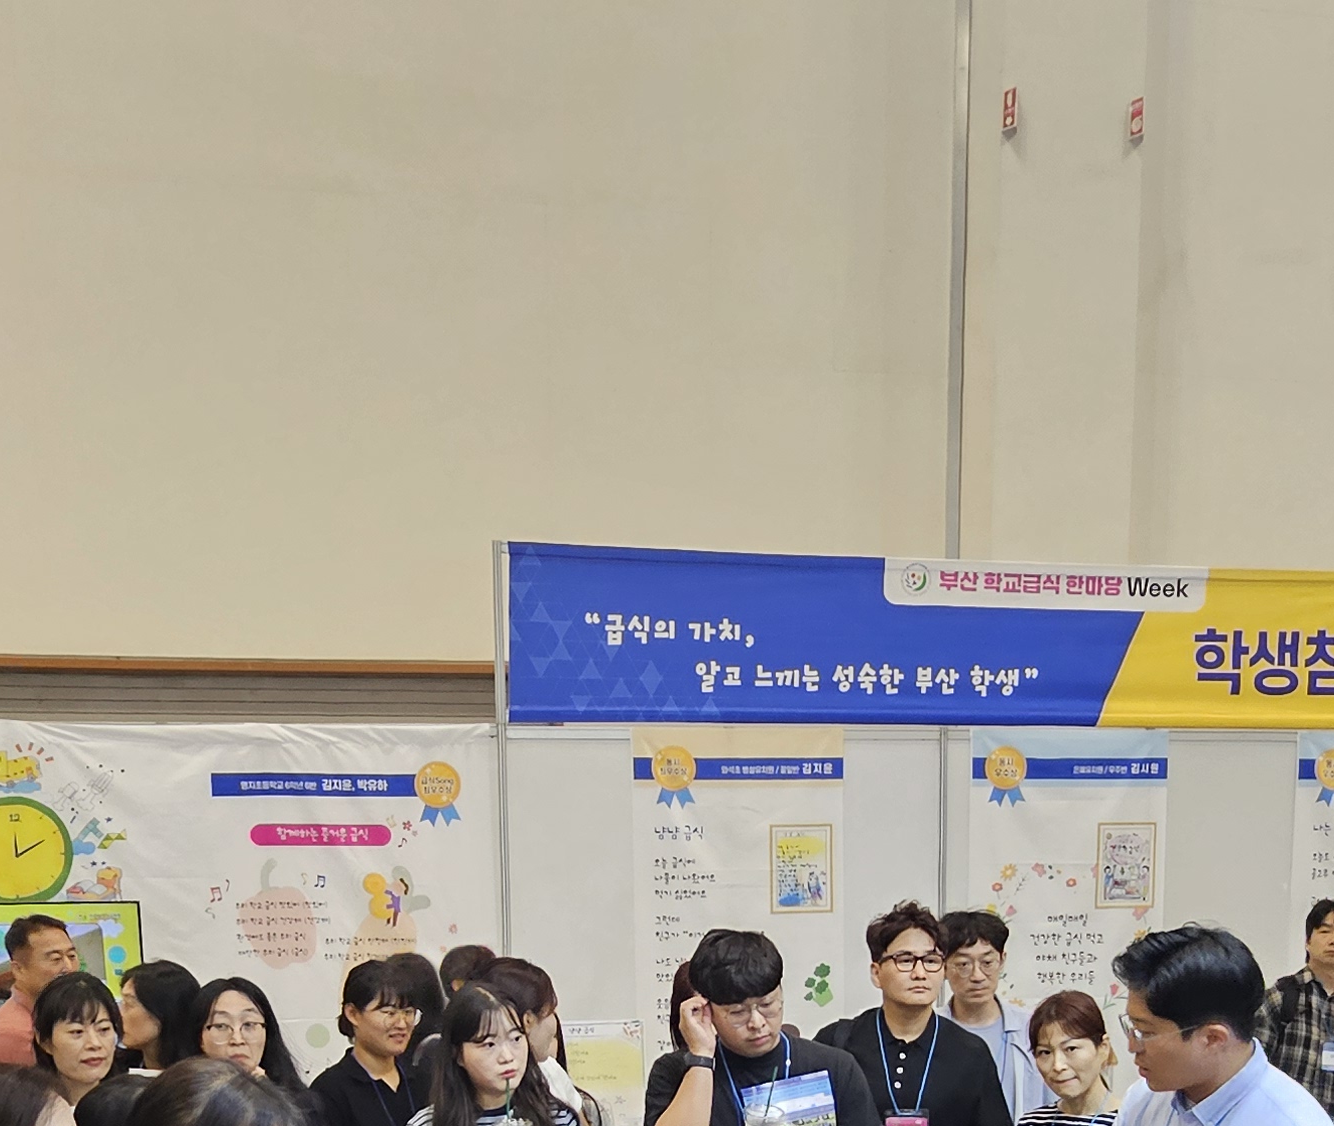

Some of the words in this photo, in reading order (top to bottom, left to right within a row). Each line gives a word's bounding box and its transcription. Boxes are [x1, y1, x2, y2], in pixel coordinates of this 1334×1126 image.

[938, 570, 980, 593] 부산
[983, 570, 1061, 595] 학교급식
[1066, 572, 1122, 597] 한마당
[1127, 576, 1189, 599] Week
[584, 611, 676, 647] “급식의
[688, 617, 755, 648] 가치,
[695, 660, 742, 691] 알고
[754, 665, 822, 691] 느끼는
[831, 663, 905, 695] 성숙한
[915, 667, 960, 695] 부산
[970, 665, 1039, 697] 학생”
[994, 767, 1017, 778] 우수상
[421, 776, 454, 787] 급식Song
[423, 786, 453, 796] 최우수상
[9, 813, 21, 823] 12
[276, 826, 319, 840] 함께하는
[320, 826, 347, 842] 즐거운
[349, 826, 369, 841] 급식
[684, 825, 705, 842] 급식
[1313, 822, 1332, 836] 나는
[654, 857, 668, 869] 오늘
[671, 857, 696, 869] 급식에
[683, 873, 716, 884] 나왔어요
[654, 889, 672, 900] 먹기
[265, 900, 277, 911] 급식
[266, 916, 277, 926] 급식
[655, 916, 681, 926] 그런데
[1047, 913, 1089, 927] 매일매일
[294, 931, 306, 941] 급식
[353, 936, 366, 946] 급식
[1030, 933, 1062, 947] 건강한
[1066, 932, 1083, 947] 급식
[1085, 933, 1105, 946] 먹고
[277, 947, 289, 957] 급식
[1061, 952, 1098, 965] 친구들과
[1037, 971, 1066, 985] 행복한
[1069, 970, 1097, 985] 우리들
